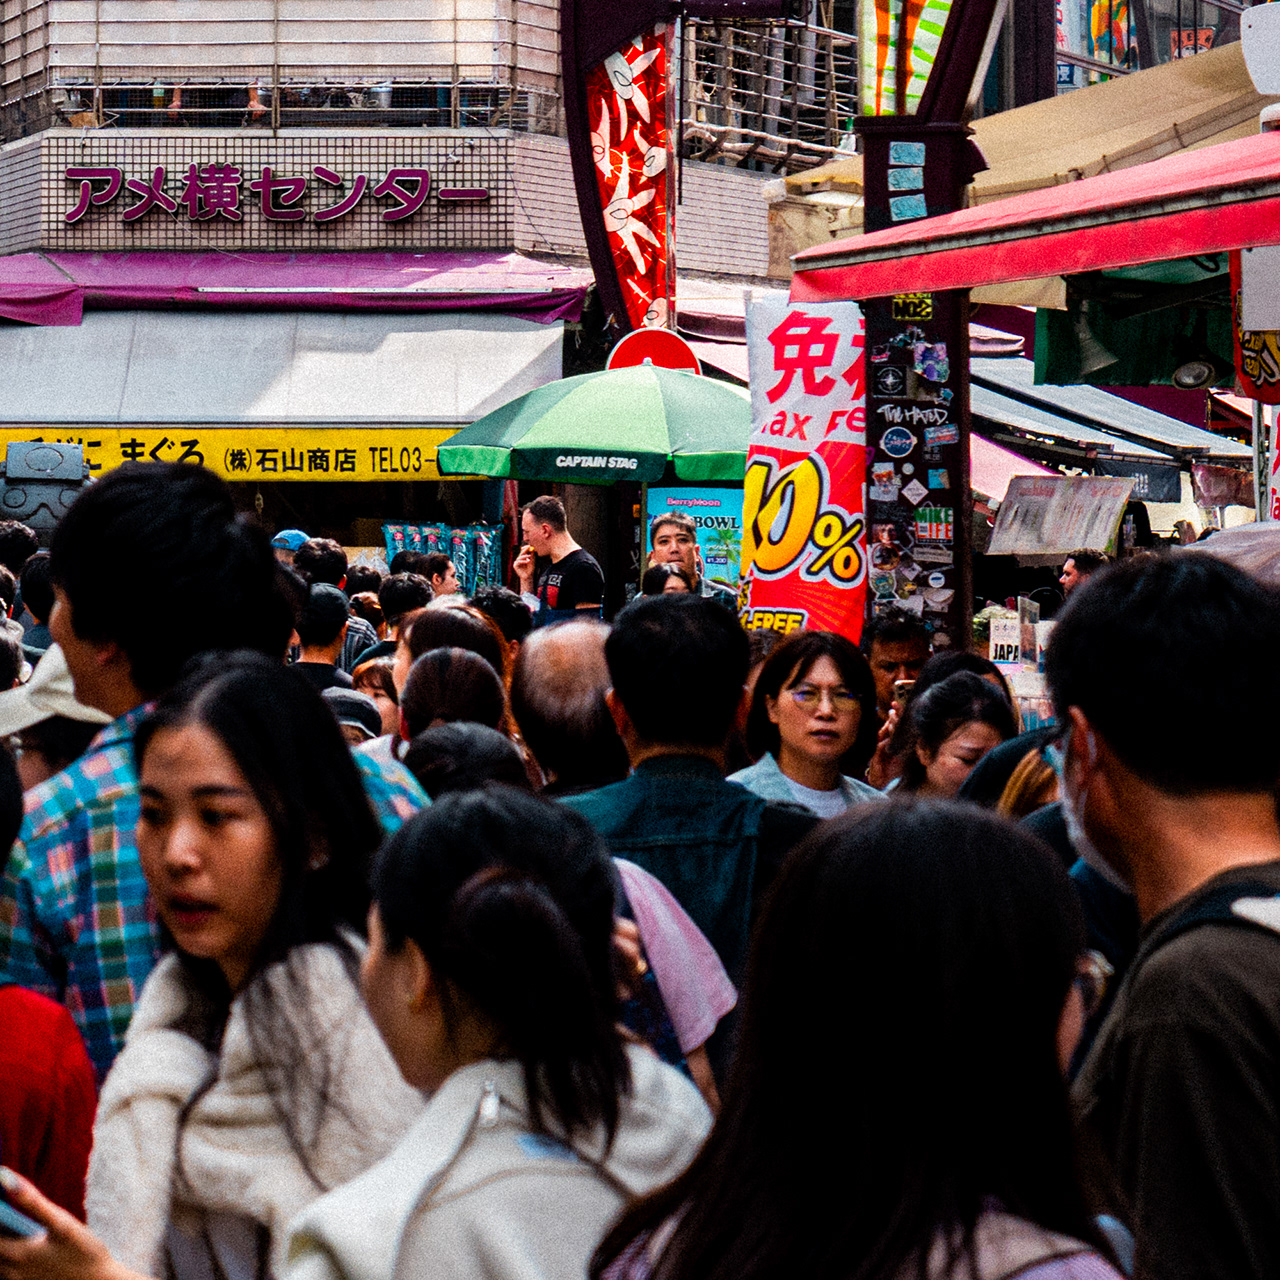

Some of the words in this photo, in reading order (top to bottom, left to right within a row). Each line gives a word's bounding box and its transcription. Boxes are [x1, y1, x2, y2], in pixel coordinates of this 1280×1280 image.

[64, 162, 488, 222] アメ横センター
[120, 436, 205, 466] まぐろ
[369, 446, 438, 474] TEL03-
[555, 454, 606, 469] CAPTAIN
[607, 457, 638, 471] STAG
[666, 497, 721, 508] BerryMoon
[695, 516, 740, 530] BOWL
